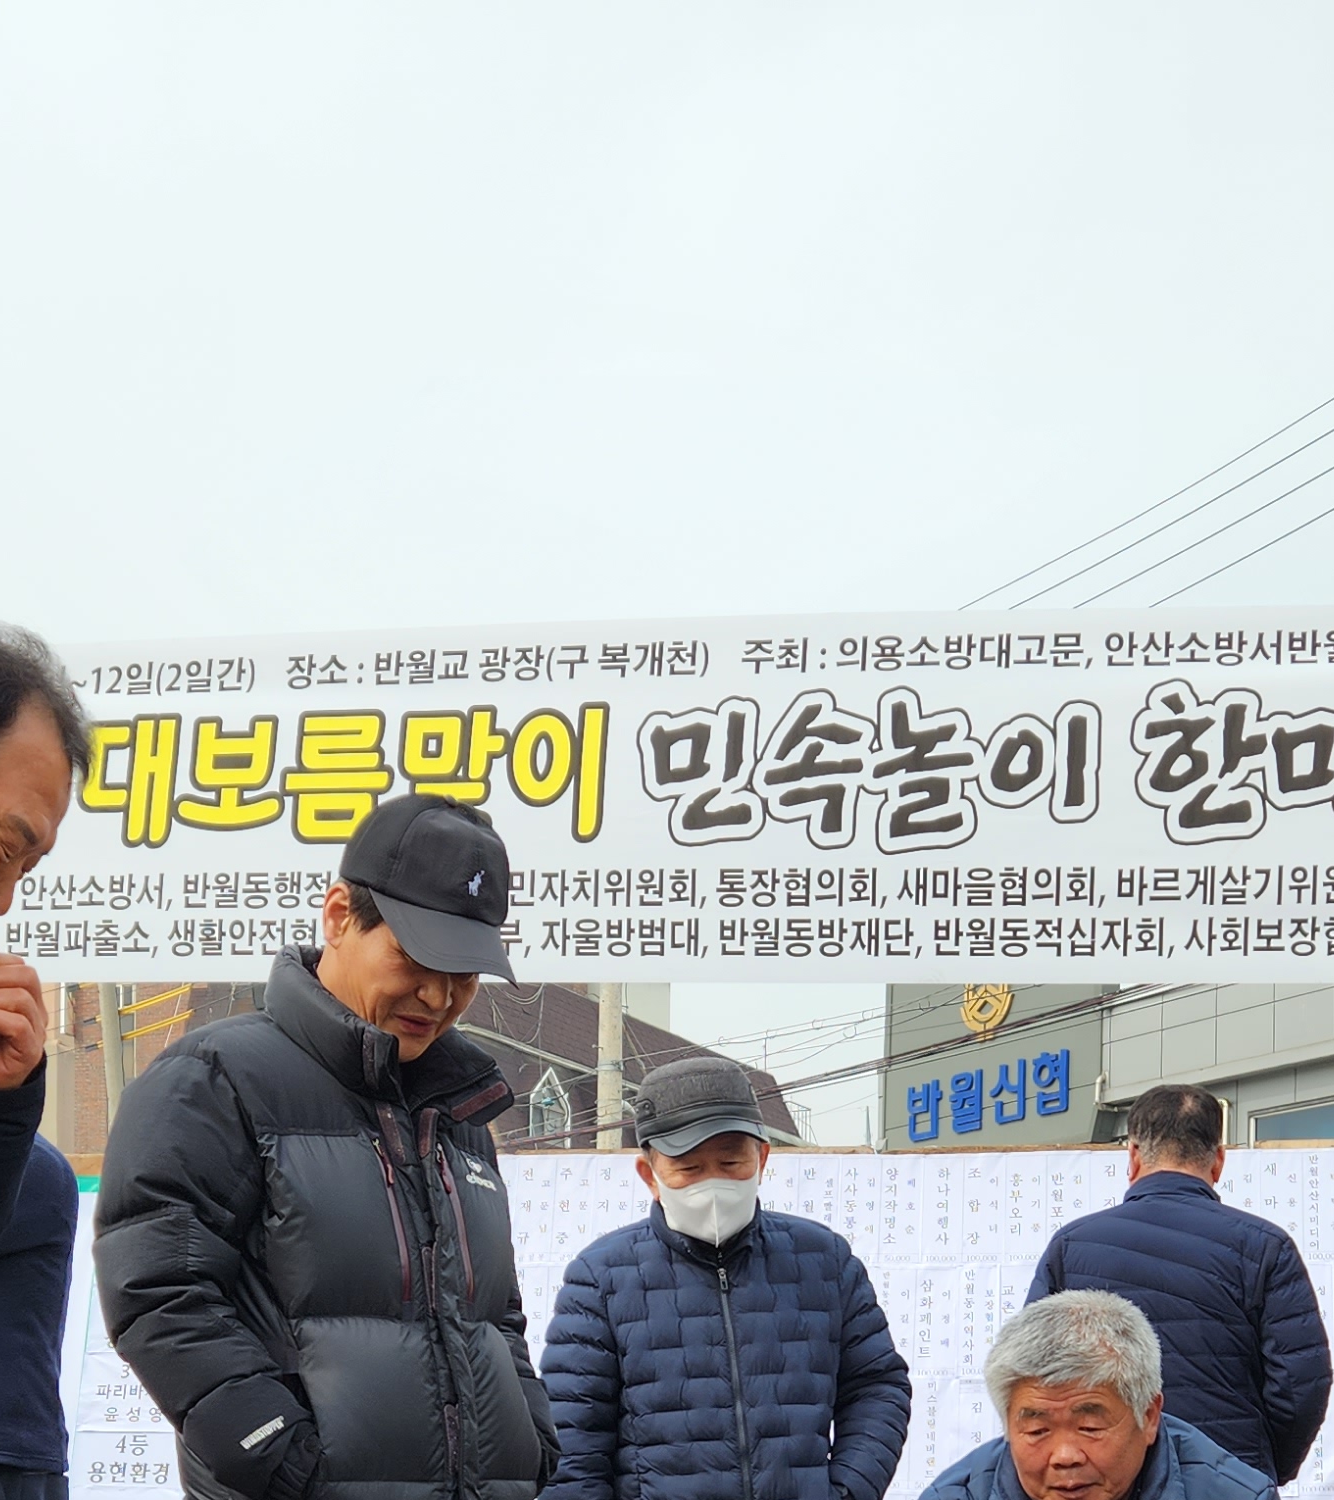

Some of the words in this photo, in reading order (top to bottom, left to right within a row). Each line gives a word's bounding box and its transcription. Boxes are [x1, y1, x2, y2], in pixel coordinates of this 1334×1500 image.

[69, 657, 256, 696] ~12일(2일간)
[284, 653, 348, 689] 장소
[373, 648, 468, 686] 반월교
[597, 639, 710, 679] 복개천)
[740, 636, 808, 675] 주최
[835, 631, 1094, 672] 의용소방대고문,
[637, 687, 1101, 854] 민속놀이
[19, 873, 173, 911] 안산소방서,
[182, 870, 333, 910] 반월동행정
[508, 867, 707, 911] 민자치위원회,
[715, 867, 888, 909] 통장협의회,
[896, 866, 1107, 909] 새마을협의회,
[5, 920, 158, 958] 반월파출소,
[539, 917, 709, 959] 자울방범대,
[718, 916, 924, 960] 반월동방재단,
[932, 916, 1176, 960] 반월동적십자회,
[907, 1048, 1071, 1144] 반월신협
[596, 1167, 612, 1238] 정지
[823, 1178, 834, 1227] 셀프빨래
[935, 1167, 951, 1246] 하나여행사
[87, 1461, 171, 1485] 용현환경
[115, 1434, 149, 1457] 4등
